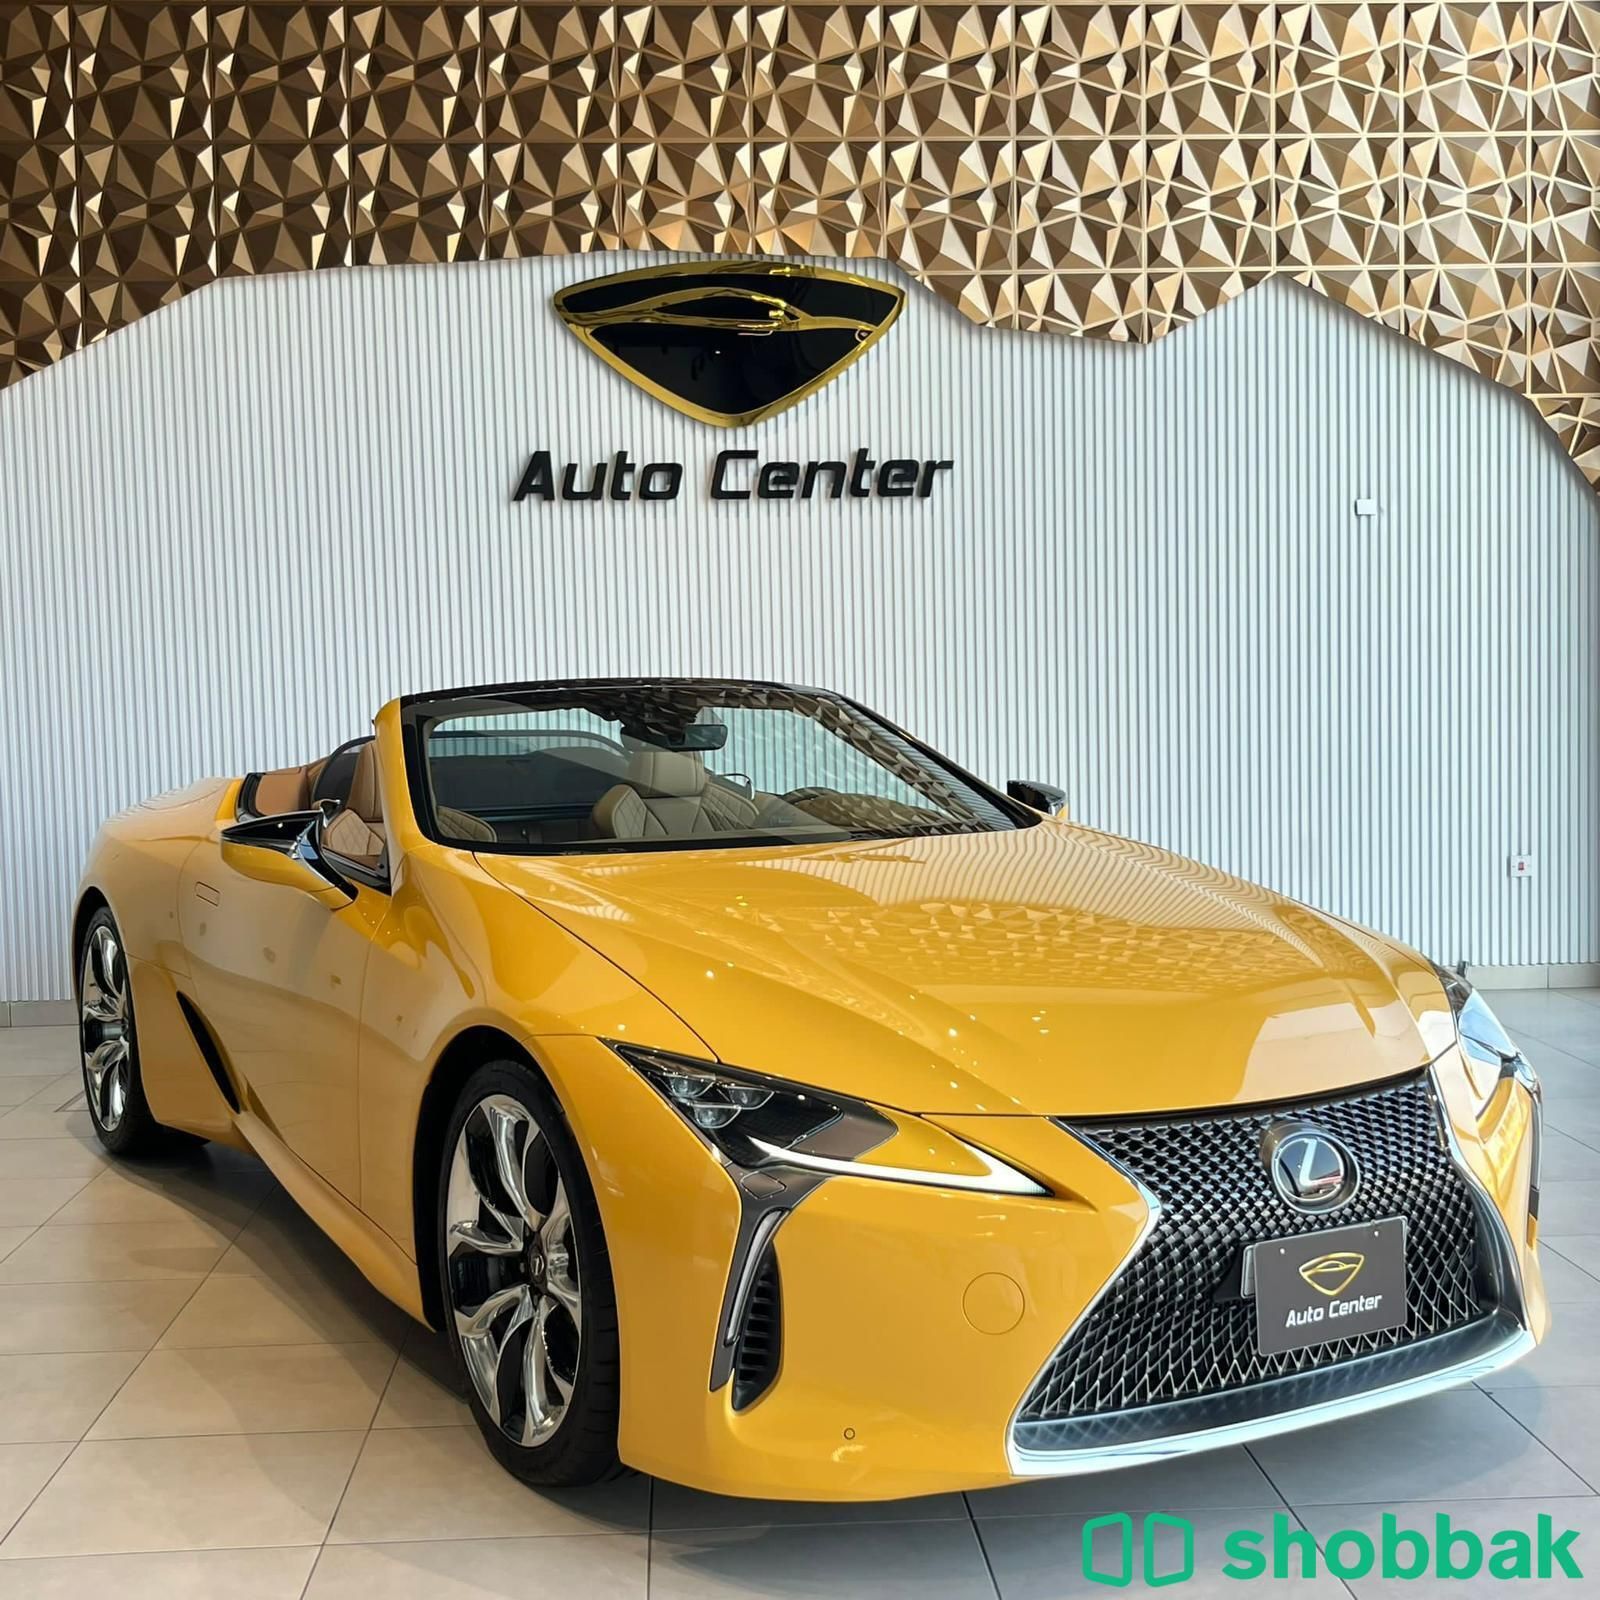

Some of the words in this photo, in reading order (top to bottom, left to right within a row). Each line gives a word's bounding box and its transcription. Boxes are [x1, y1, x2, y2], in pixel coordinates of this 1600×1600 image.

[513, 450, 684, 501] Auto
[711, 448, 955, 499] Center
[1285, 1304, 1325, 1329] Auto
[1328, 1295, 1383, 1319] Center
